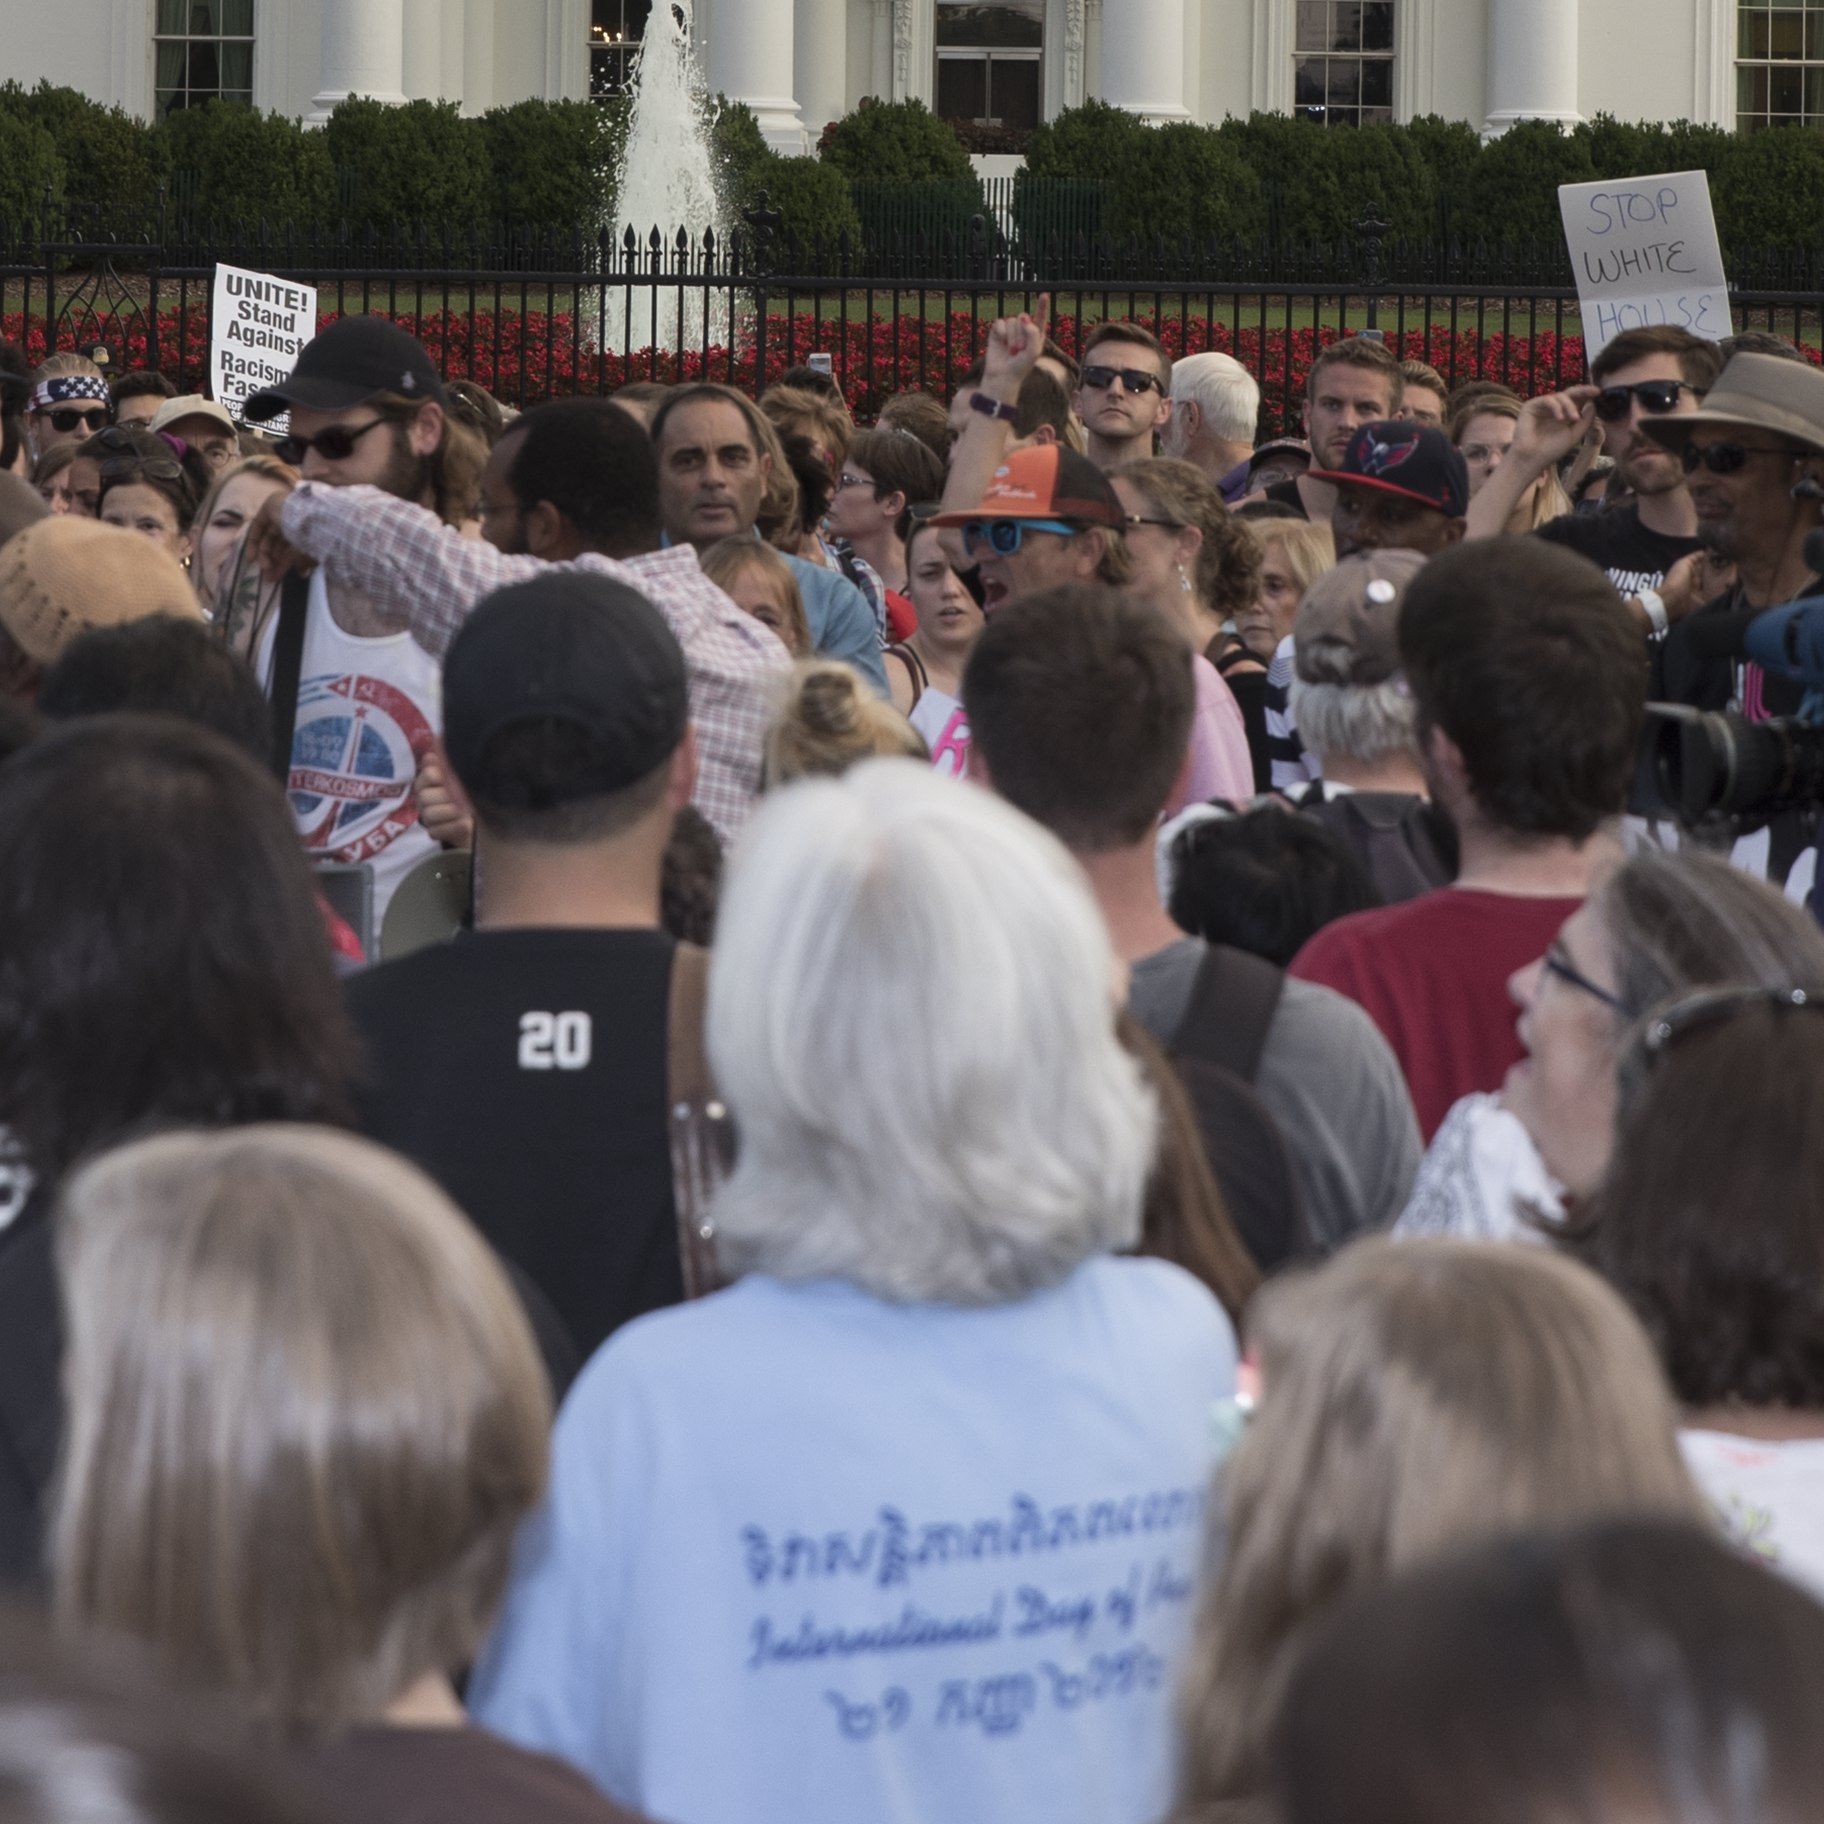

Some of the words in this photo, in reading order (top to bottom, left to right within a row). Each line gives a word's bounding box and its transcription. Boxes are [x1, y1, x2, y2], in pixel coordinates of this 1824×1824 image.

[1586, 187, 1679, 235] STOP
[1583, 240, 1697, 284] WHITE
[226, 274, 308, 313] UNITE!
[237, 300, 296, 334] Stand
[1596, 294, 1717, 343] HOUSE
[226, 320, 305, 357] Against
[220, 349, 293, 383] Racism
[517, 1010, 593, 1071] 20
